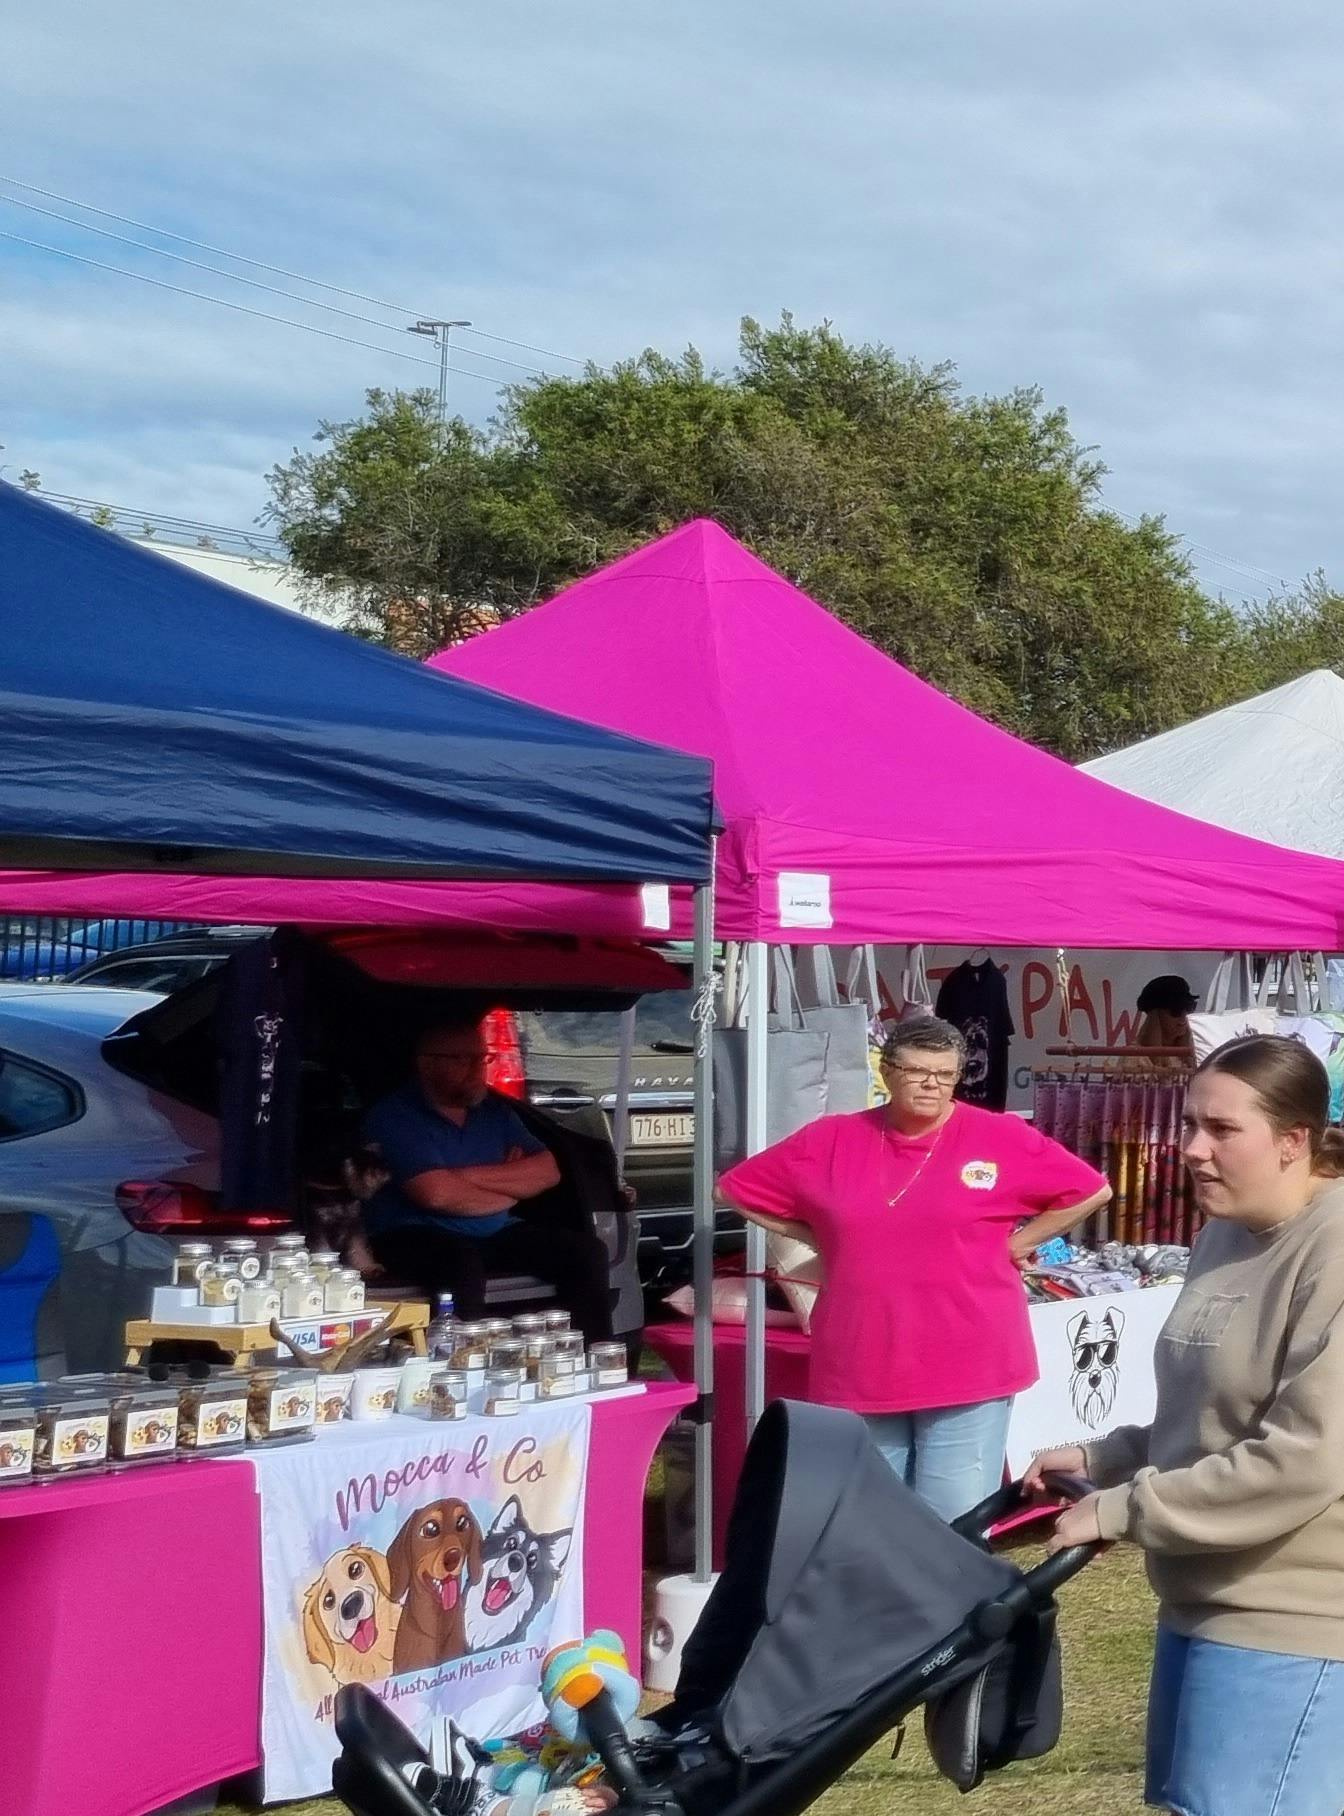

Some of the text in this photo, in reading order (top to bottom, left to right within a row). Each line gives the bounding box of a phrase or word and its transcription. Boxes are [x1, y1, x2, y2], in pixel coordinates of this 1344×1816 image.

[1021, 962, 1150, 1048] PAW
[634, 1076, 694, 1087] HAVA
[336, 1435, 547, 1531] Mocca & Co
[314, 1694, 334, 1721] All
[391, 1671, 458, 1701] Australian
[459, 1655, 496, 1680] Made
[501, 1650, 522, 1669] Pet
[921, 1645, 954, 1676] strider
